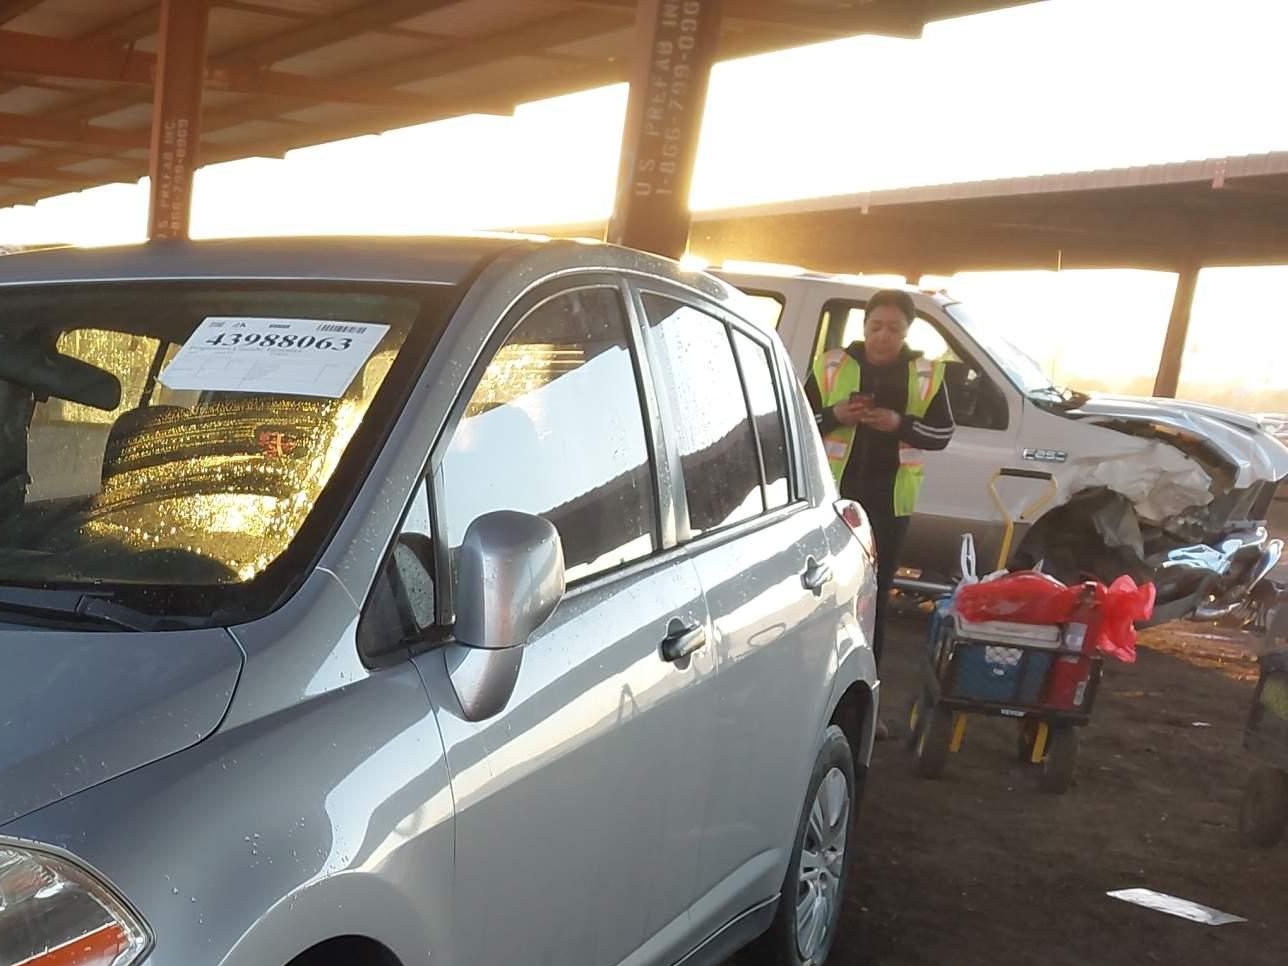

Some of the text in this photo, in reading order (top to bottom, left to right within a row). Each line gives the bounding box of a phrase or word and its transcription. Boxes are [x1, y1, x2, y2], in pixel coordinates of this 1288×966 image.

[636, 0, 680, 197] U S PREFAB IN
[206, 332, 353, 352] 43988063
